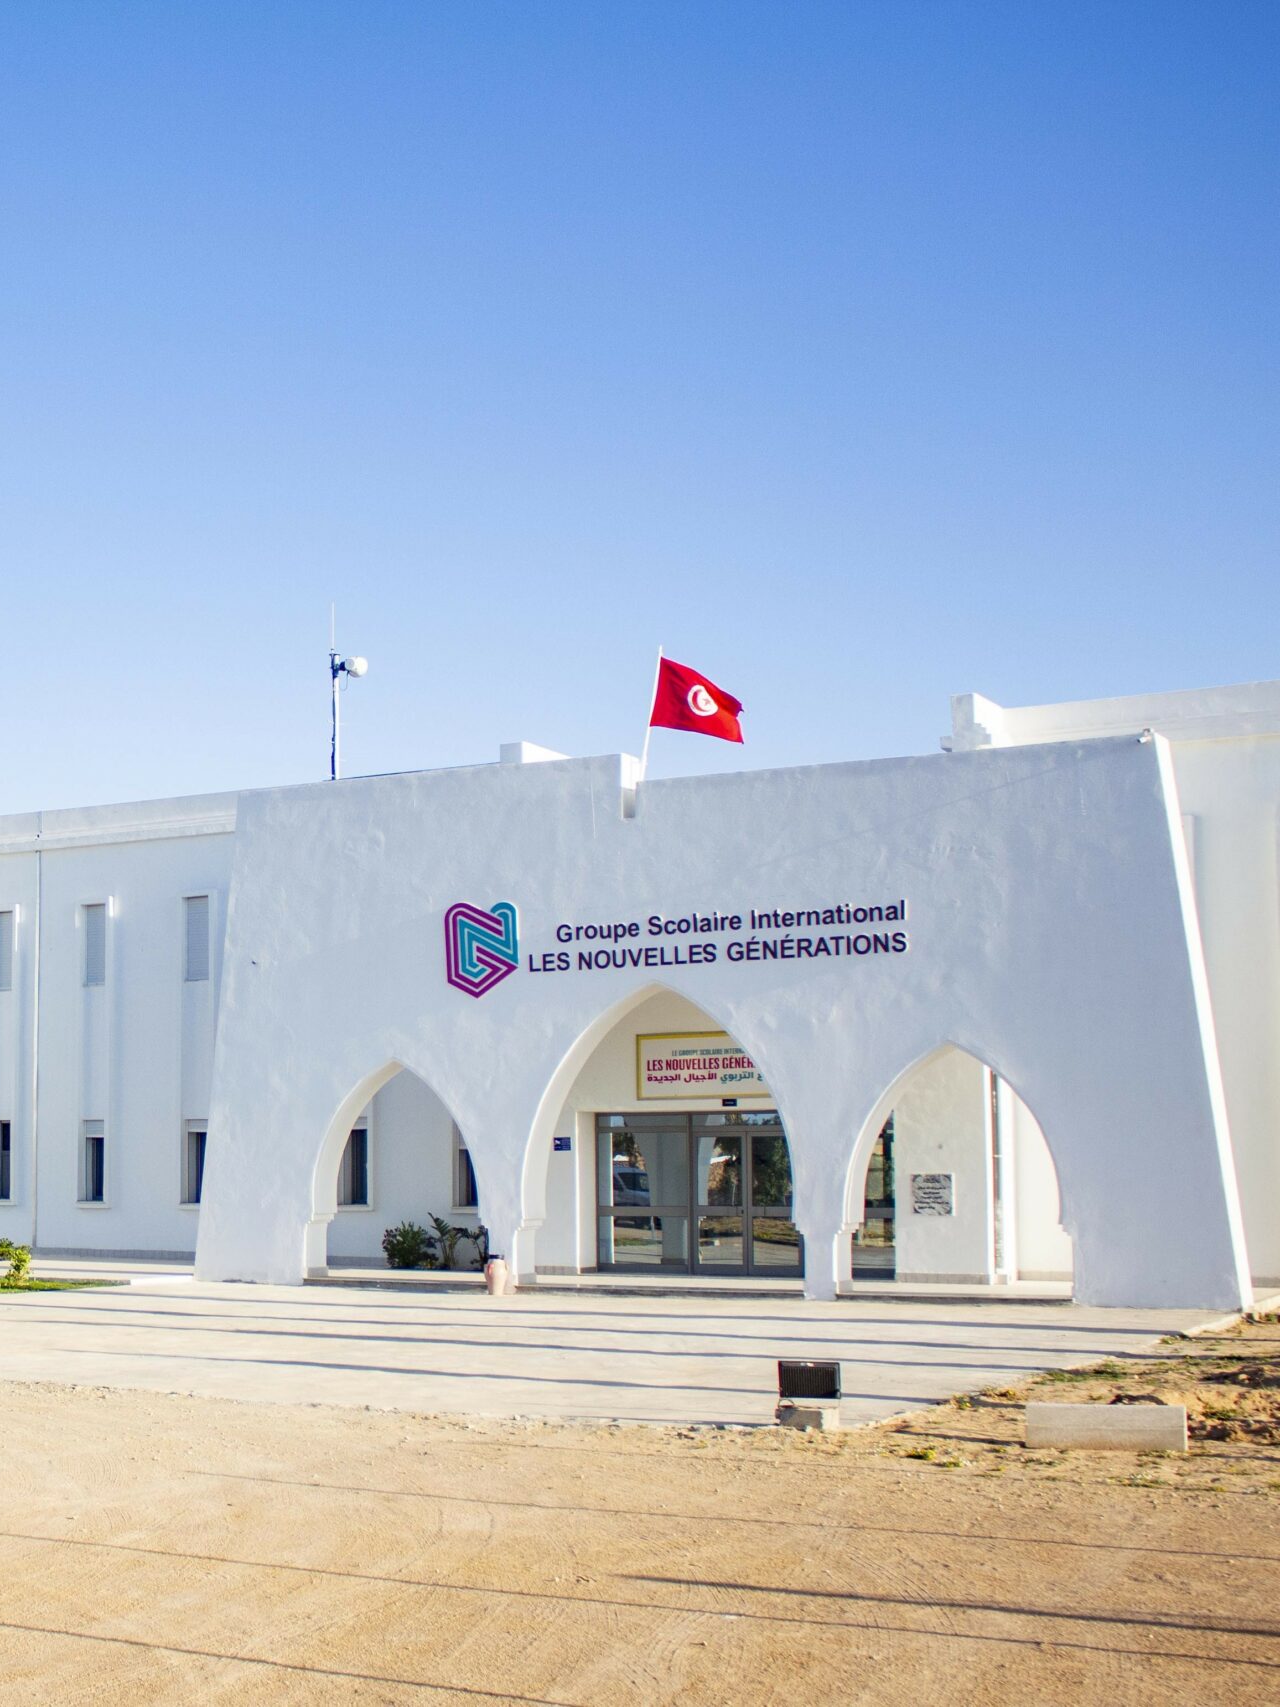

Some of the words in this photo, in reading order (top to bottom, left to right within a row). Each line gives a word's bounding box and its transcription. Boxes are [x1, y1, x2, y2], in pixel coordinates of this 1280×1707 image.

[556, 920, 640, 943] Groupe
[648, 912, 742, 936] Scolaire
[751, 900, 906, 930] International
[529, 952, 570, 973] LES
[578, 944, 717, 971] NOUVELLES
[727, 932, 908, 962] GÉNÉRATIONS
[647, 1060, 663, 1071] LES
[665, 1057, 719, 1071] NOUVELLES
[647, 1073, 680, 1083] الجديدة
[684, 1071, 717, 1083] الأجيال
